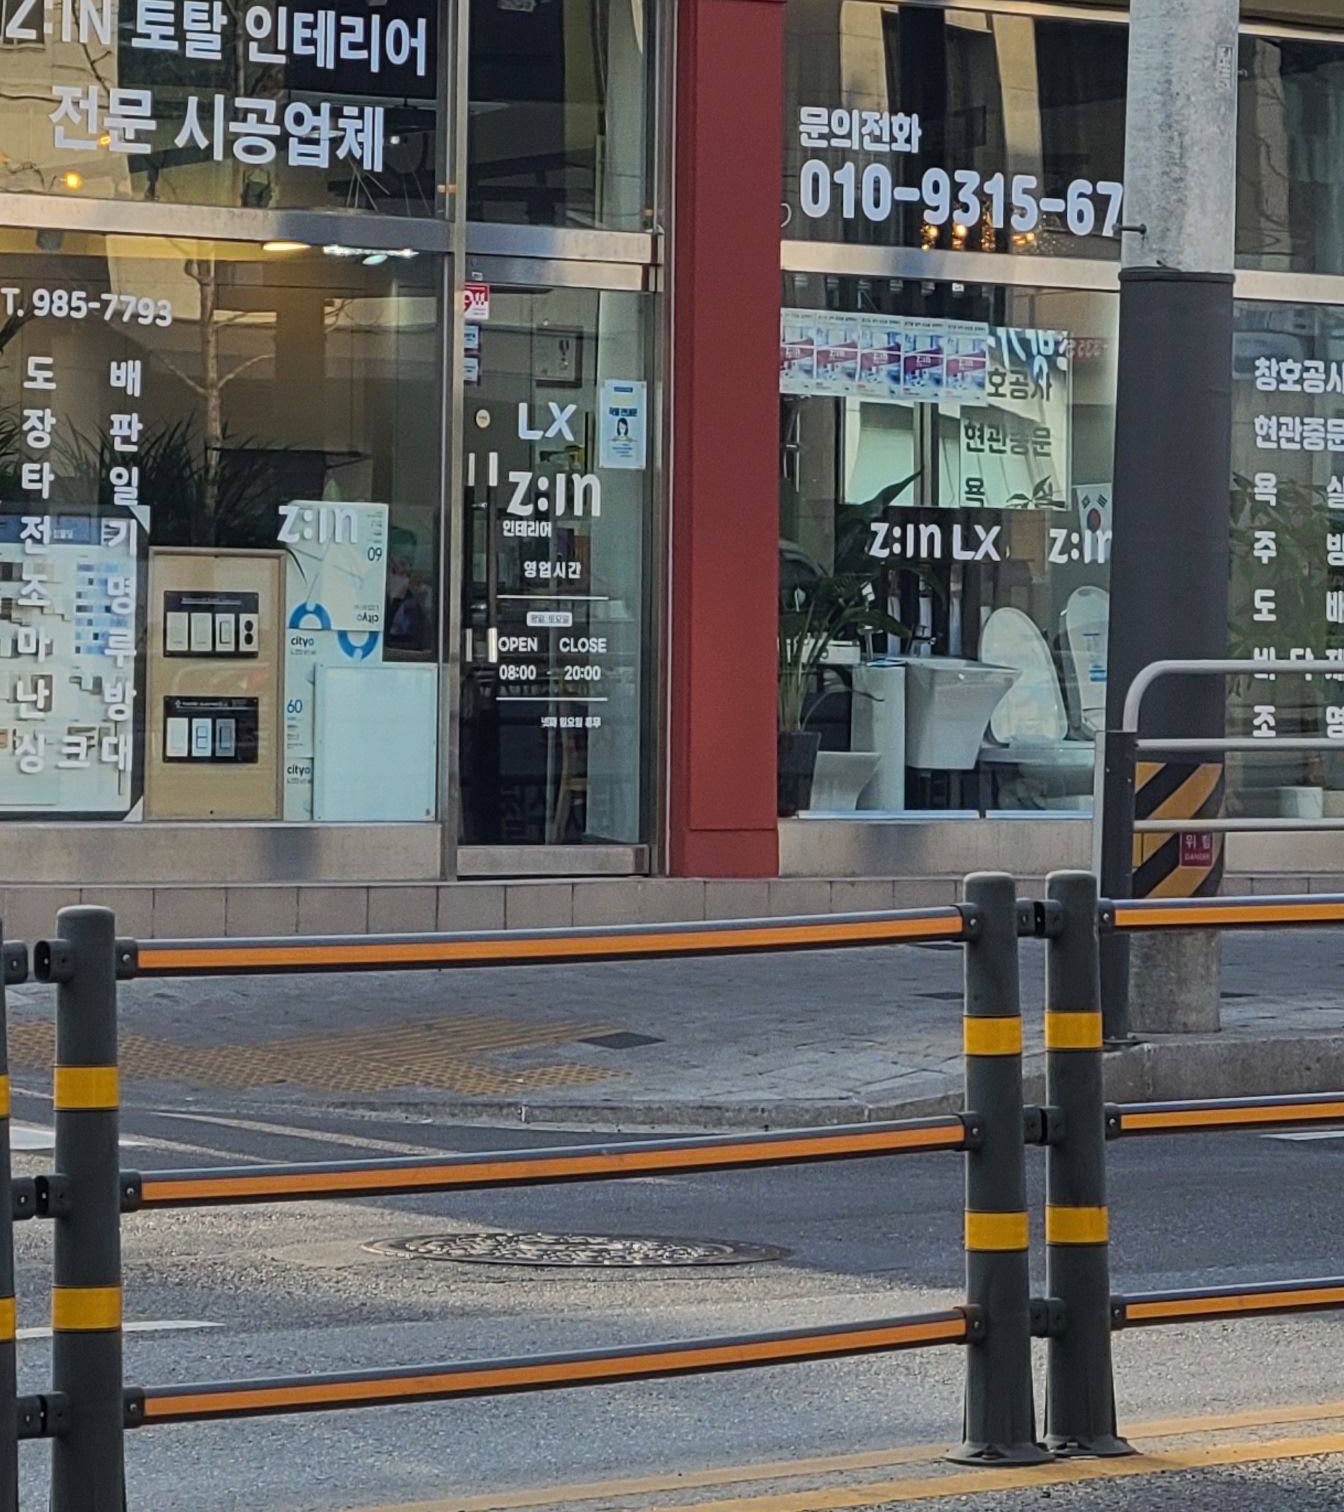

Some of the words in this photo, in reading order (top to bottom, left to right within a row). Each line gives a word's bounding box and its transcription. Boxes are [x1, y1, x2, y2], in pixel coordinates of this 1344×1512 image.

[246, 5, 426, 76] 인테리어
[49, 84, 157, 155] 전문
[174, 93, 384, 172] 시공업체
[800, 106, 922, 154] 문의전화
[800, 159, 1123, 237] 010-9315-67
[32, 287, 172, 328] 985-7793
[518, 401, 577, 441] LX
[502, 520, 552, 538] 인테리어
[953, 524, 1001, 561] LX
[524, 561, 582, 579] 영업시간
[498, 636, 538, 652] OPEN
[559, 637, 606, 653] CLOSE
[499, 664, 537, 681] 08:00
[564, 665, 601, 681] 20:00
[286, 699, 303, 714] 60
